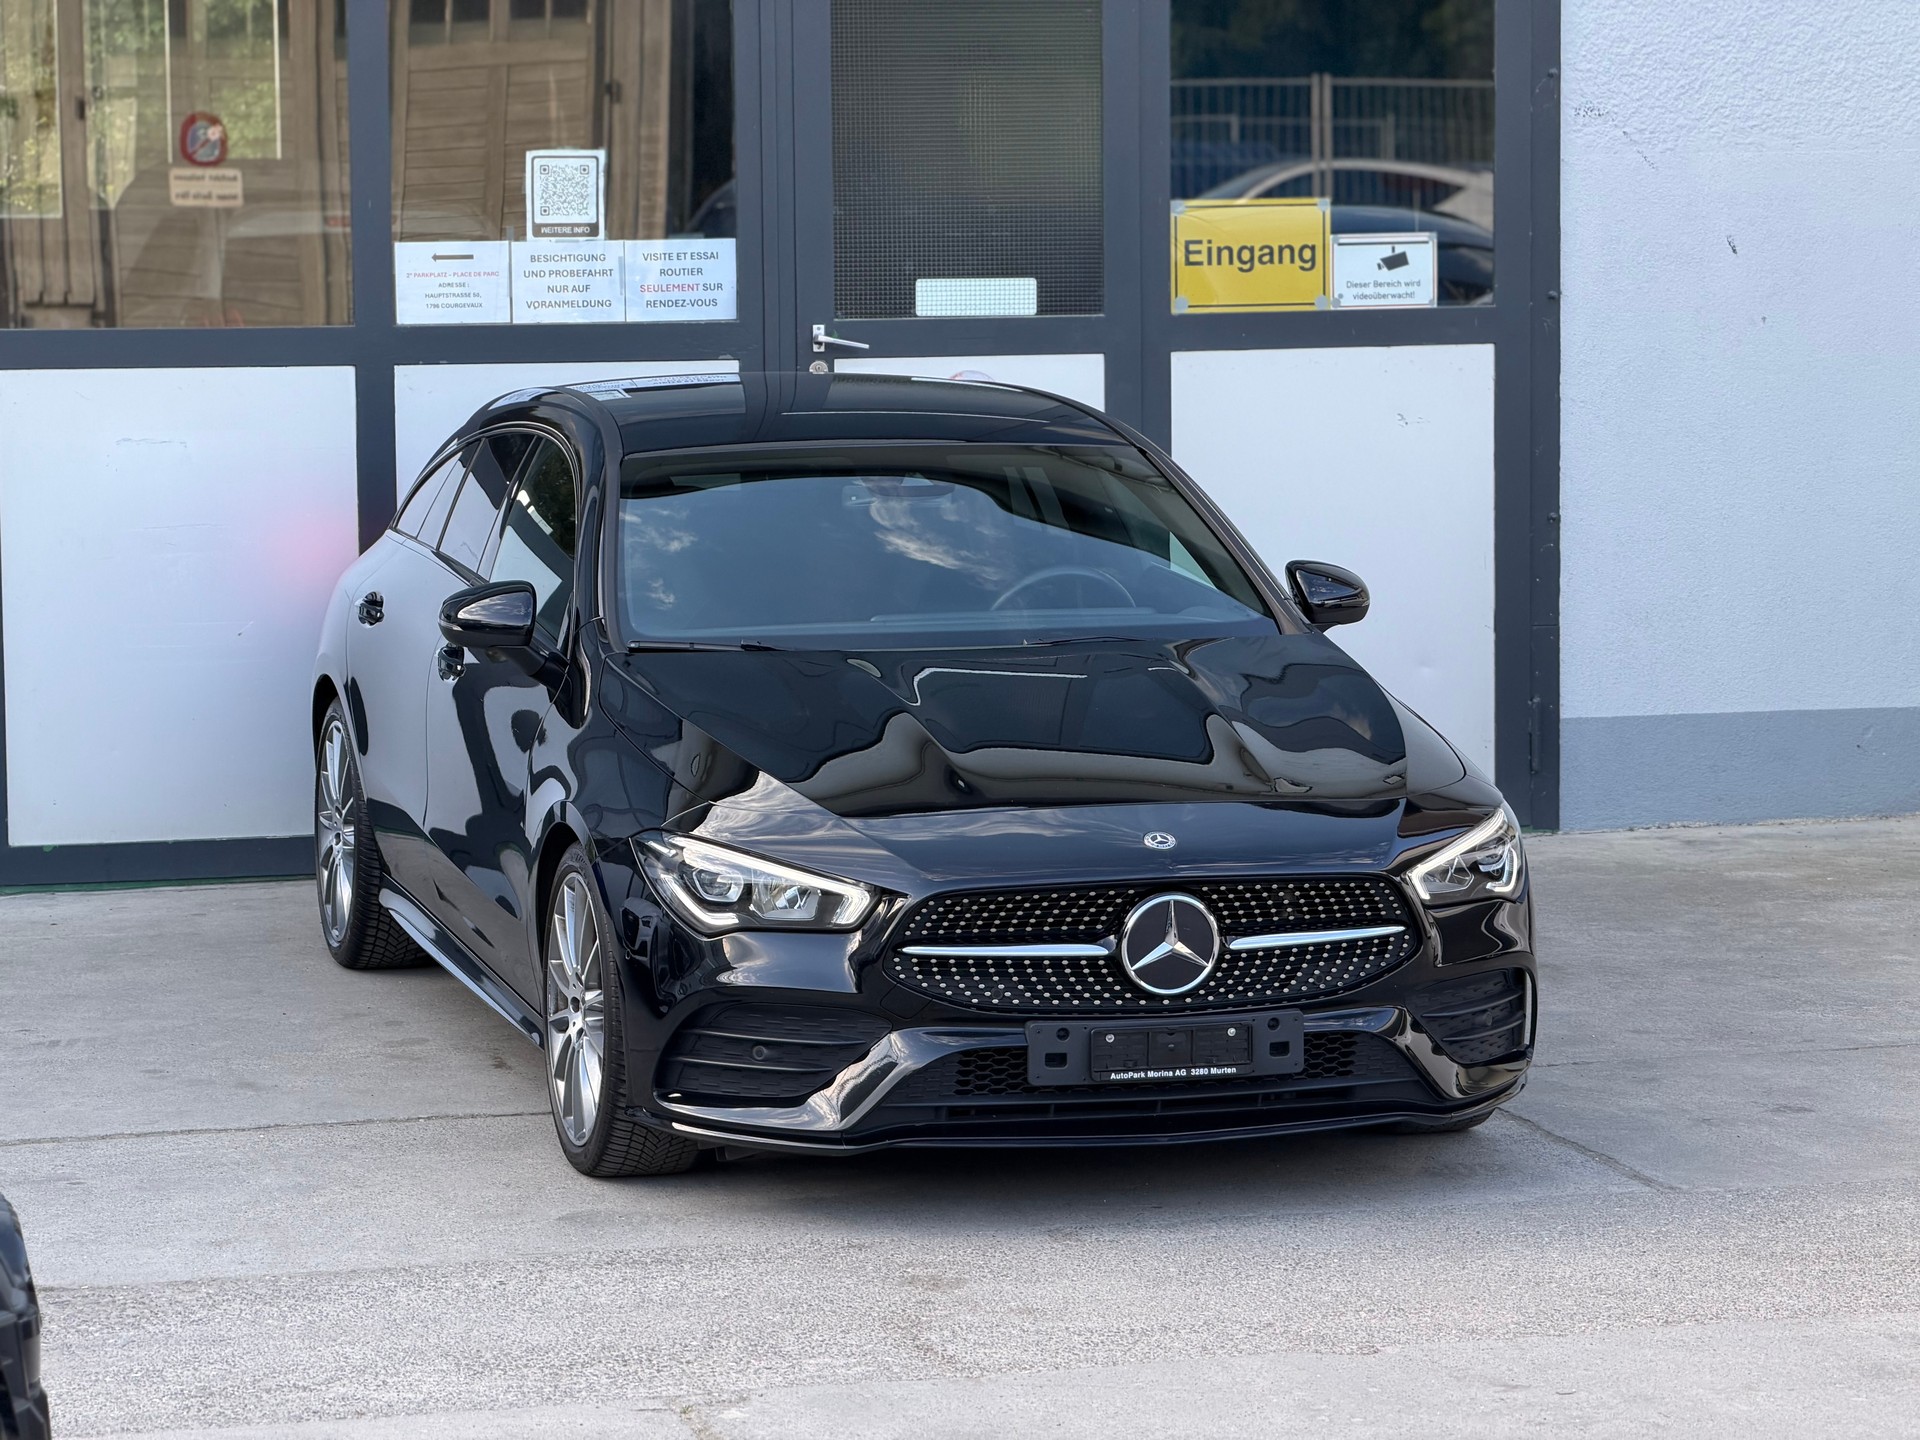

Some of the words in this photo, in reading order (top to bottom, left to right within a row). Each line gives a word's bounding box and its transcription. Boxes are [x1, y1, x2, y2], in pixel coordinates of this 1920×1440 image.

[541, 226, 572, 234] WEITERE
[530, 253, 606, 263] BESICHTIGUNG
[642, 252, 674, 261] VISITE
[676, 252, 688, 260] ET
[690, 251, 719, 260] ESSAI
[1183, 239, 1317, 273] Eingang
[523, 269, 546, 278] UND
[548, 268, 614, 278] PROBEFAHRT
[659, 267, 703, 277] ROUTIER
[547, 285, 569, 293] NUR
[571, 284, 591, 293] AUF
[640, 283, 700, 293] SEULEMENT
[702, 283, 723, 291] SUR
[1346, 280, 1371, 289] Dieser
[1373, 280, 1402, 288] Bereich
[1404, 279, 1421, 287] wird
[1352, 291, 1415, 300] videoüberwacht!
[526, 299, 612, 309] VORANMELDUNG
[646, 298, 718, 308] RENDEZ-VOUS
[1110, 1071, 1146, 1080] AutoPark
[1148, 1070, 1173, 1078] Morina
